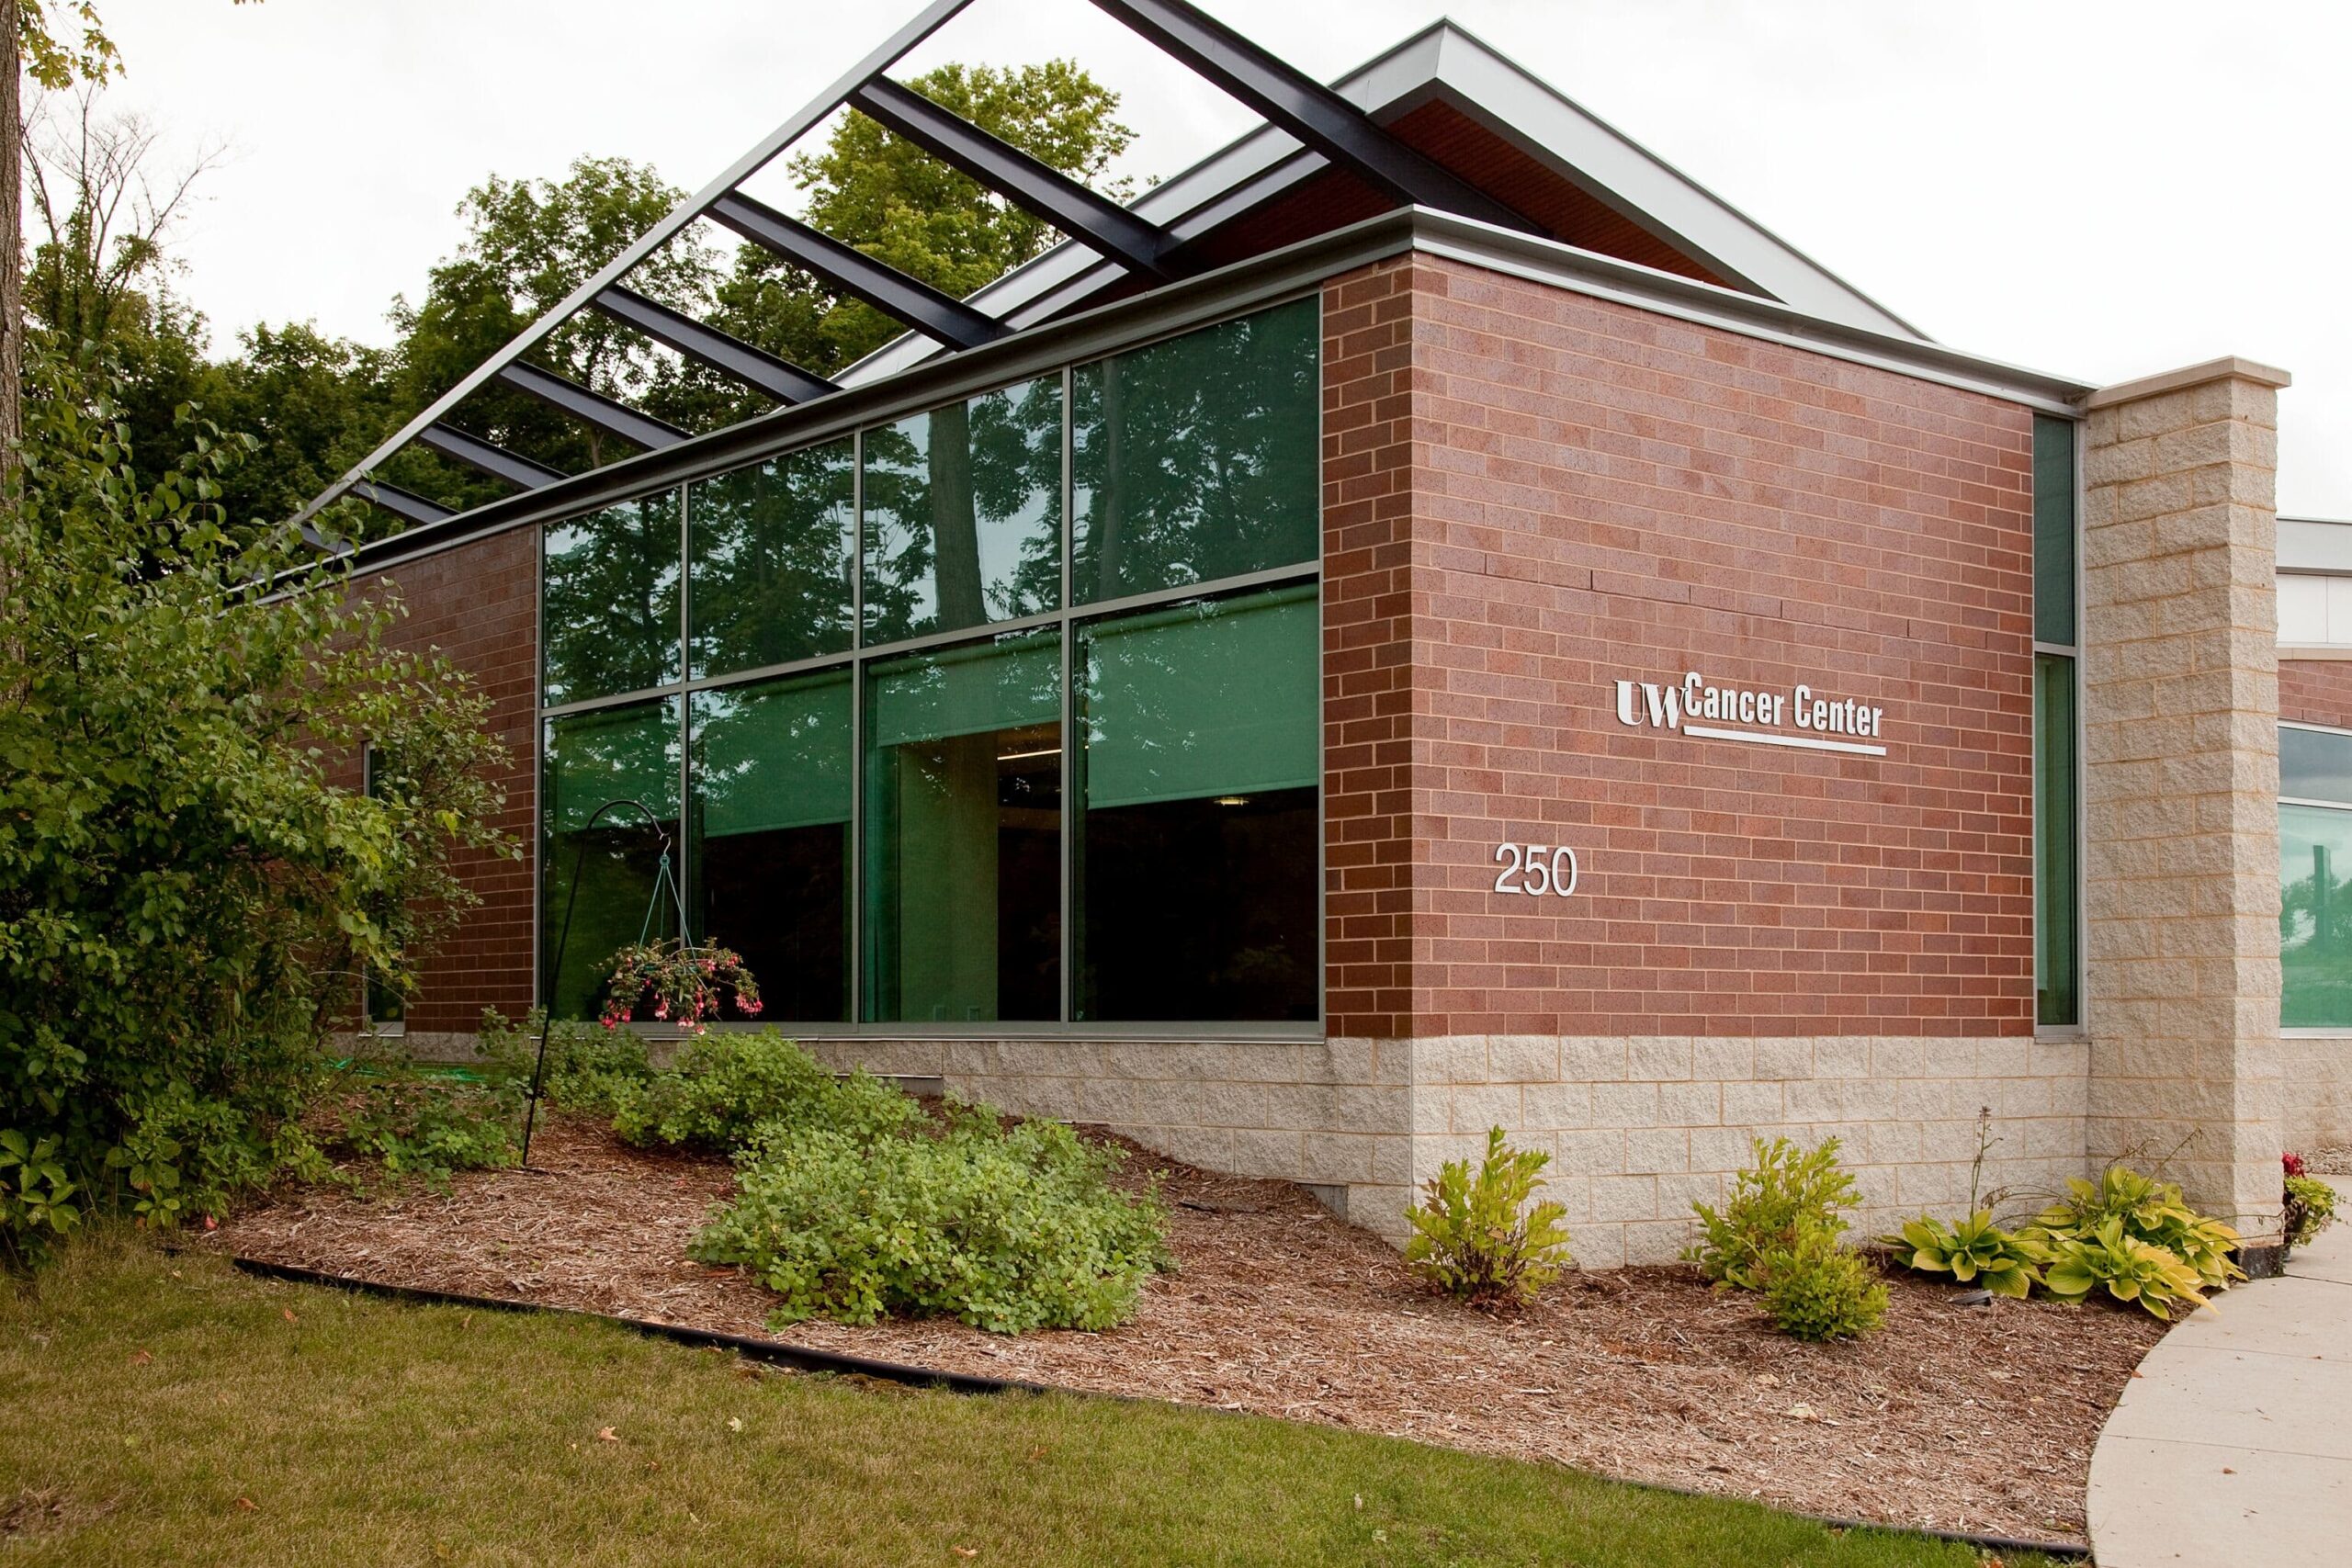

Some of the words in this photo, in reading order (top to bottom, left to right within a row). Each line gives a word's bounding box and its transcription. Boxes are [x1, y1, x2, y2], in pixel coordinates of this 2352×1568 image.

[1613, 679, 1688, 729] UW
[1684, 671, 1784, 726] Cancer
[1793, 684, 1883, 737] Center
[1494, 842, 1577, 897] 250
